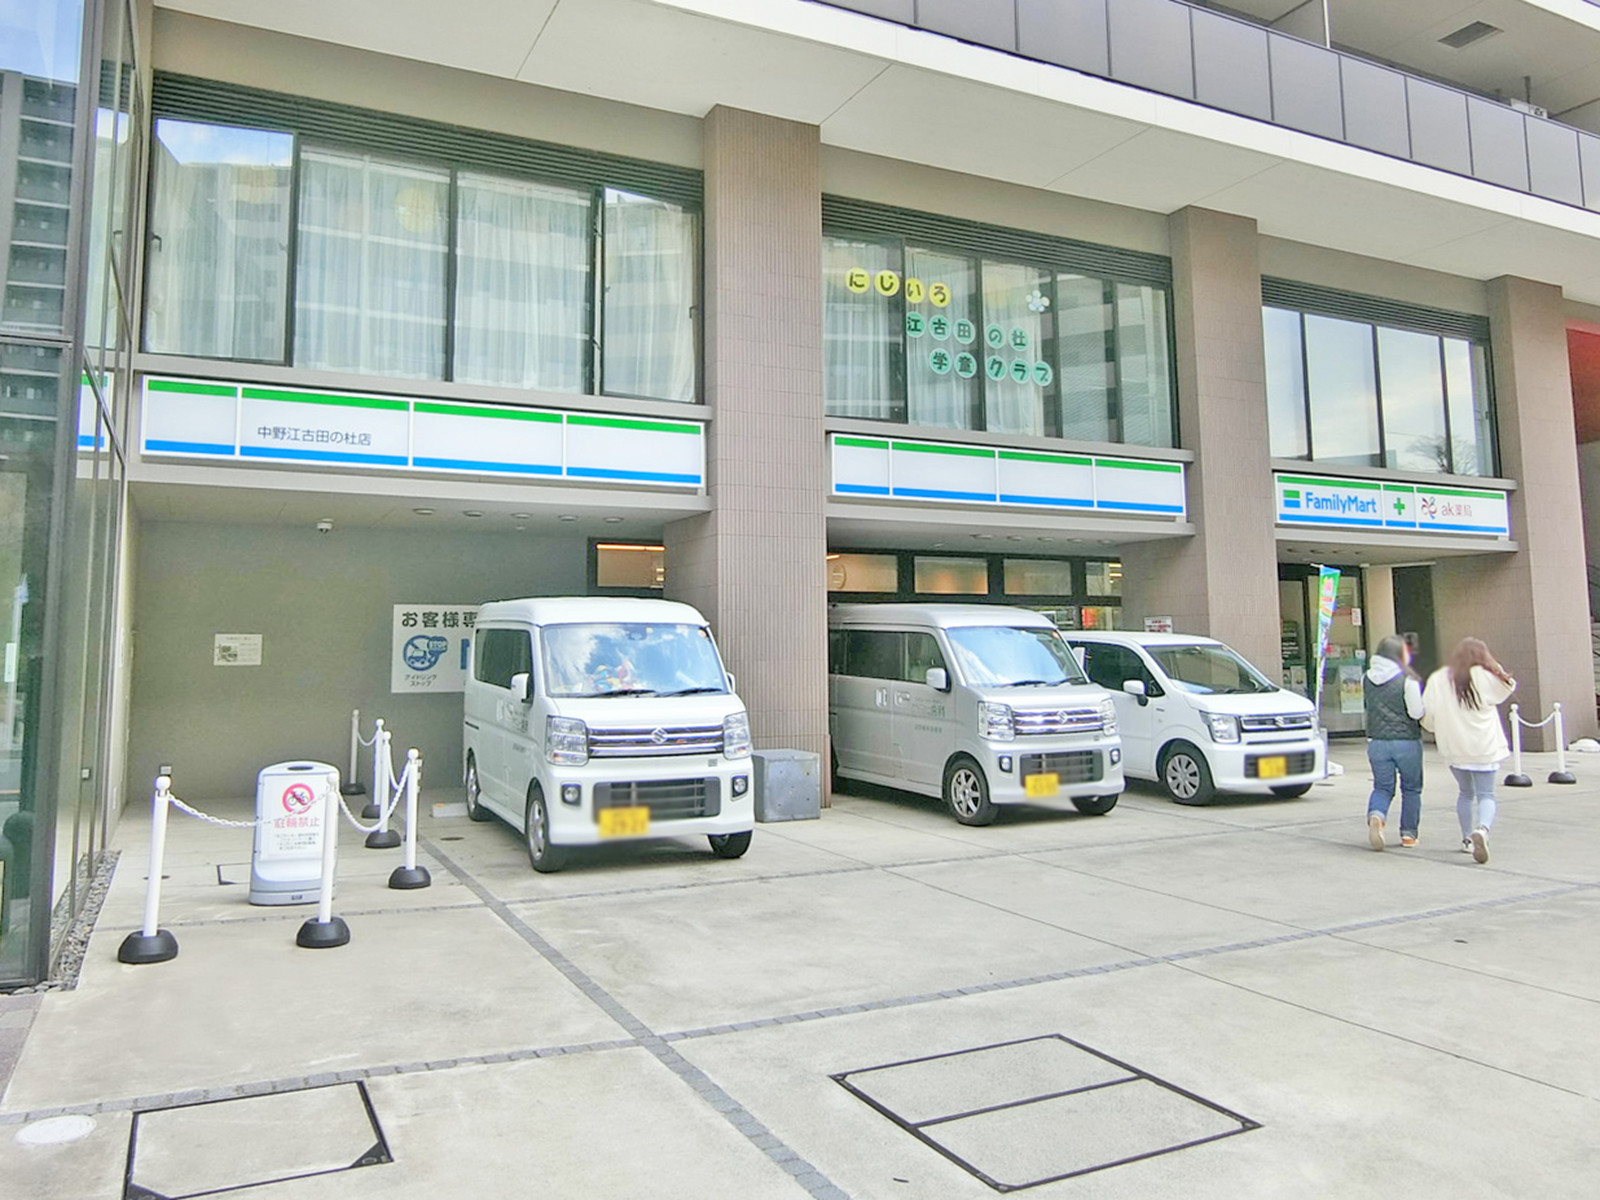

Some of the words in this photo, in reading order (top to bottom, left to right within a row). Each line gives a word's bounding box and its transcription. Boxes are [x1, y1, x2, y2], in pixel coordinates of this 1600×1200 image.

[849, 271, 947, 303] にじいろ
[932, 351, 1050, 383] 学童クラブ
[257, 425, 372, 446] 中野江古田の杜店
[1305, 491, 1377, 514] FamilyMart
